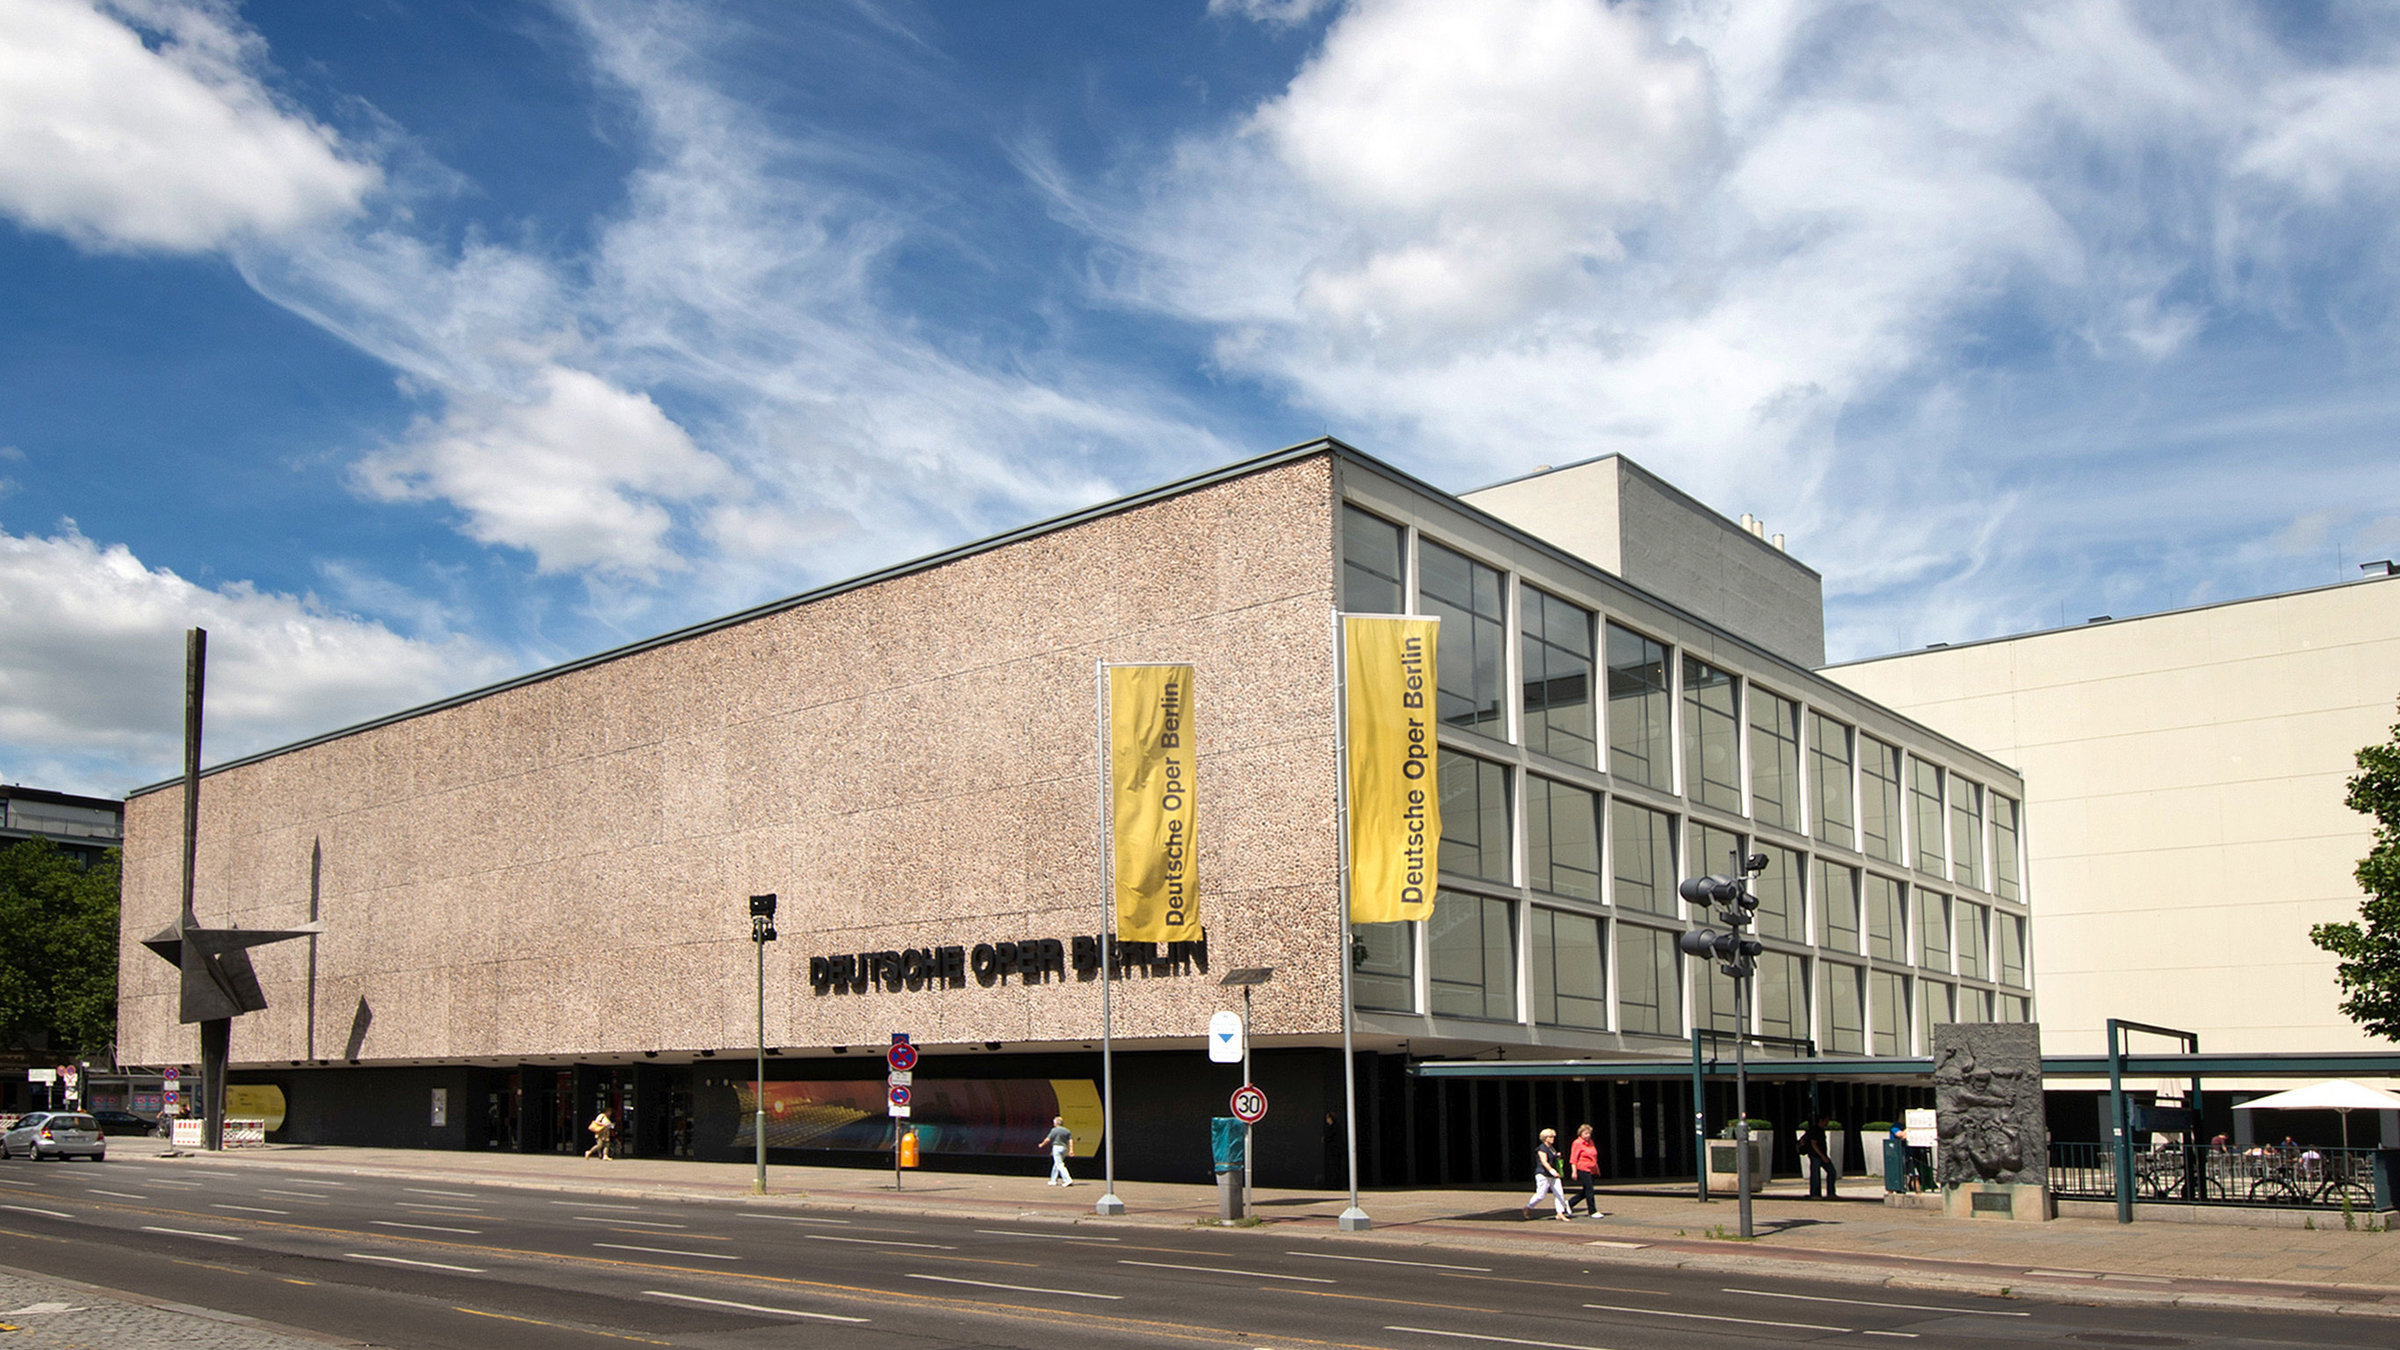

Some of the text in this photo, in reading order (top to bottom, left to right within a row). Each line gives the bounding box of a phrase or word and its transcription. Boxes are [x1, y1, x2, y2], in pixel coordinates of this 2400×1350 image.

[1160, 682, 1186, 927] Deutsche Oper Berlin
[1401, 637, 1428, 904] Deutsche Oper Berlin
[810, 946, 964, 987] DEUTSCHE
[971, 938, 1063, 977] OPER
[1238, 1094, 1260, 1114] 30
